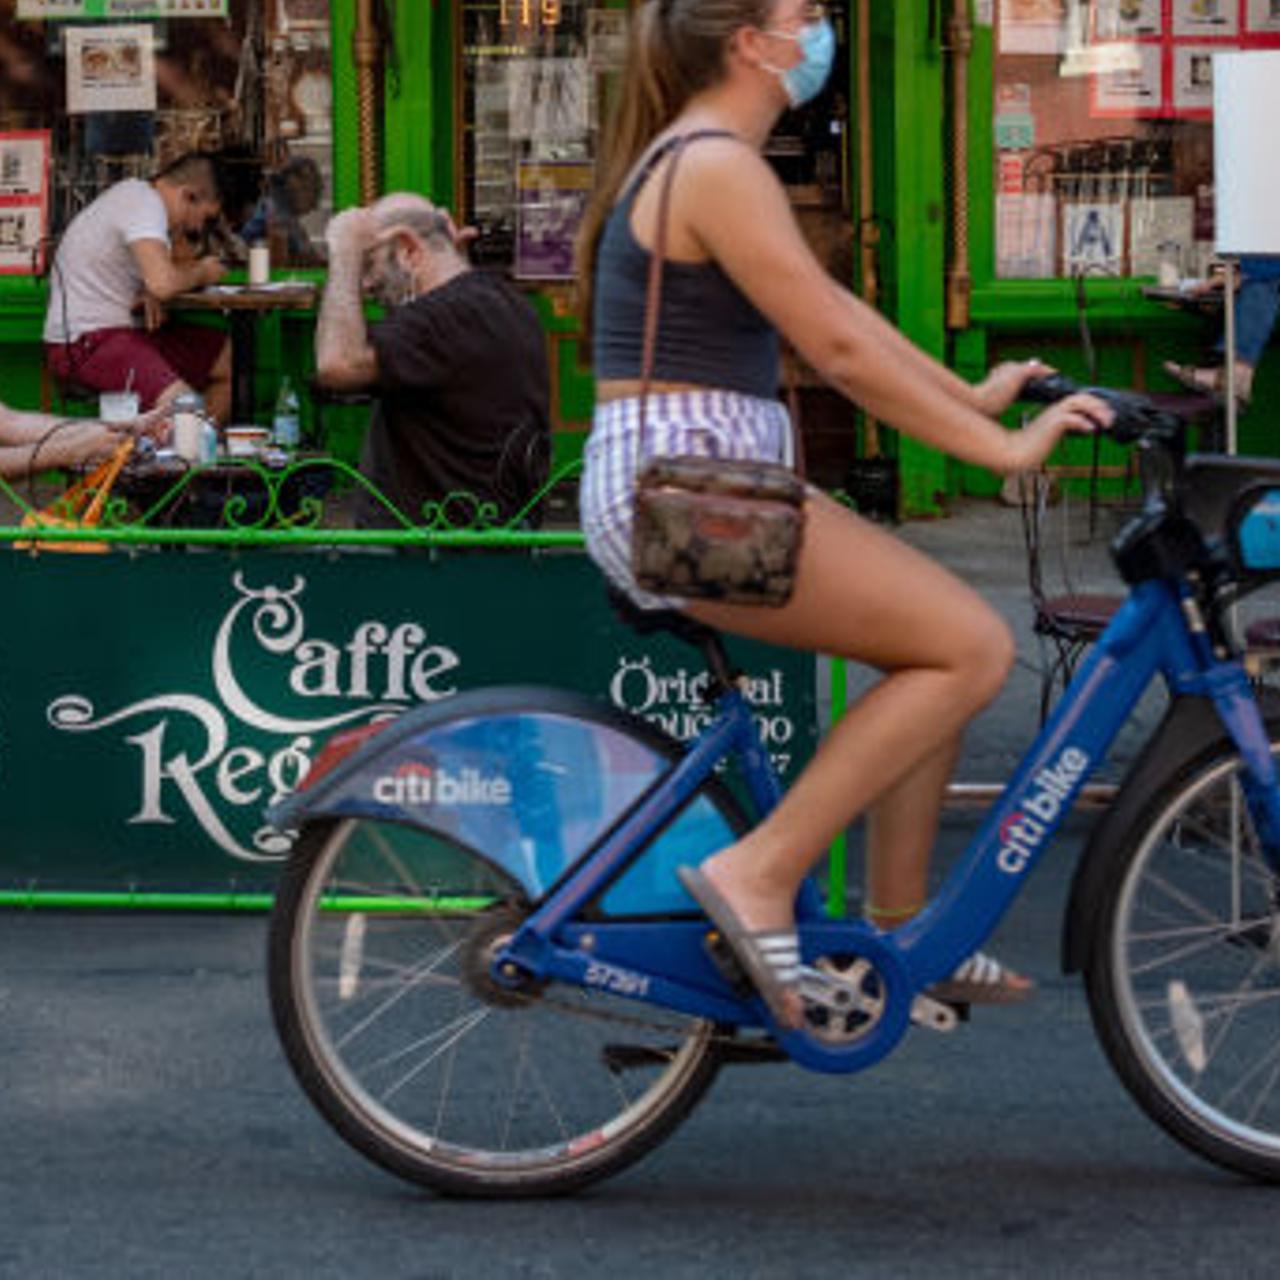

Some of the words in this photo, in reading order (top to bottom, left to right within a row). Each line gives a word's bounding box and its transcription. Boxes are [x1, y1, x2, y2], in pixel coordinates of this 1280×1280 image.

[212, 570, 460, 732] Caffe
[373, 764, 432, 805] citi
[437, 770, 513, 805] bike
[997, 812, 1046, 874] citi
[1022, 746, 1089, 823] bike
